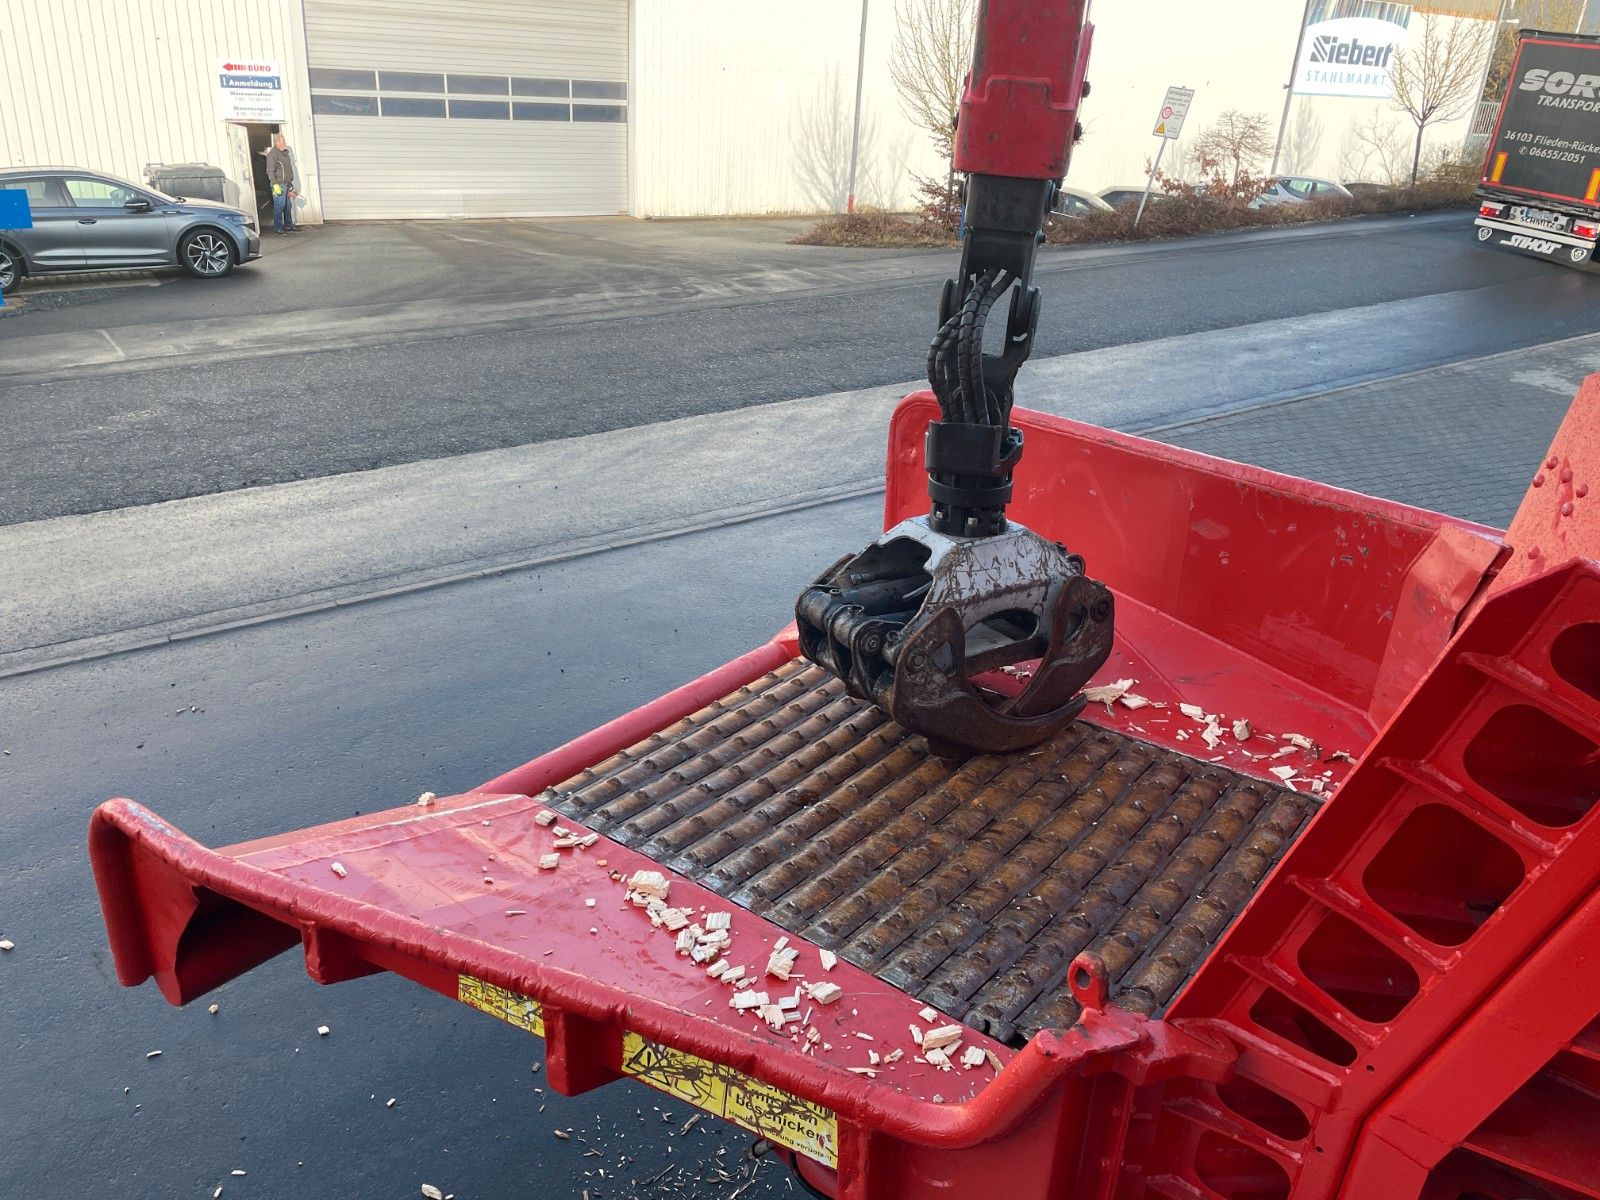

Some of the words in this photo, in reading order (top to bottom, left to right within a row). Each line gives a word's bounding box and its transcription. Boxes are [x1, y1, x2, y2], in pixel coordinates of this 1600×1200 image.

[1310, 35, 1393, 67] Siebert
[248, 64, 271, 72] BÜRO
[229, 79, 273, 88] Anmeldung
[1306, 70, 1387, 86] STAHLMARKT
[1519, 68, 1600, 99] SOR
[1504, 130, 1533, 143] 36103
[1534, 135, 1600, 153] Flieden-Rücke
[1529, 146, 1586, 164] 06655/2051
[1520, 216, 1556, 229] SCHMITZ
